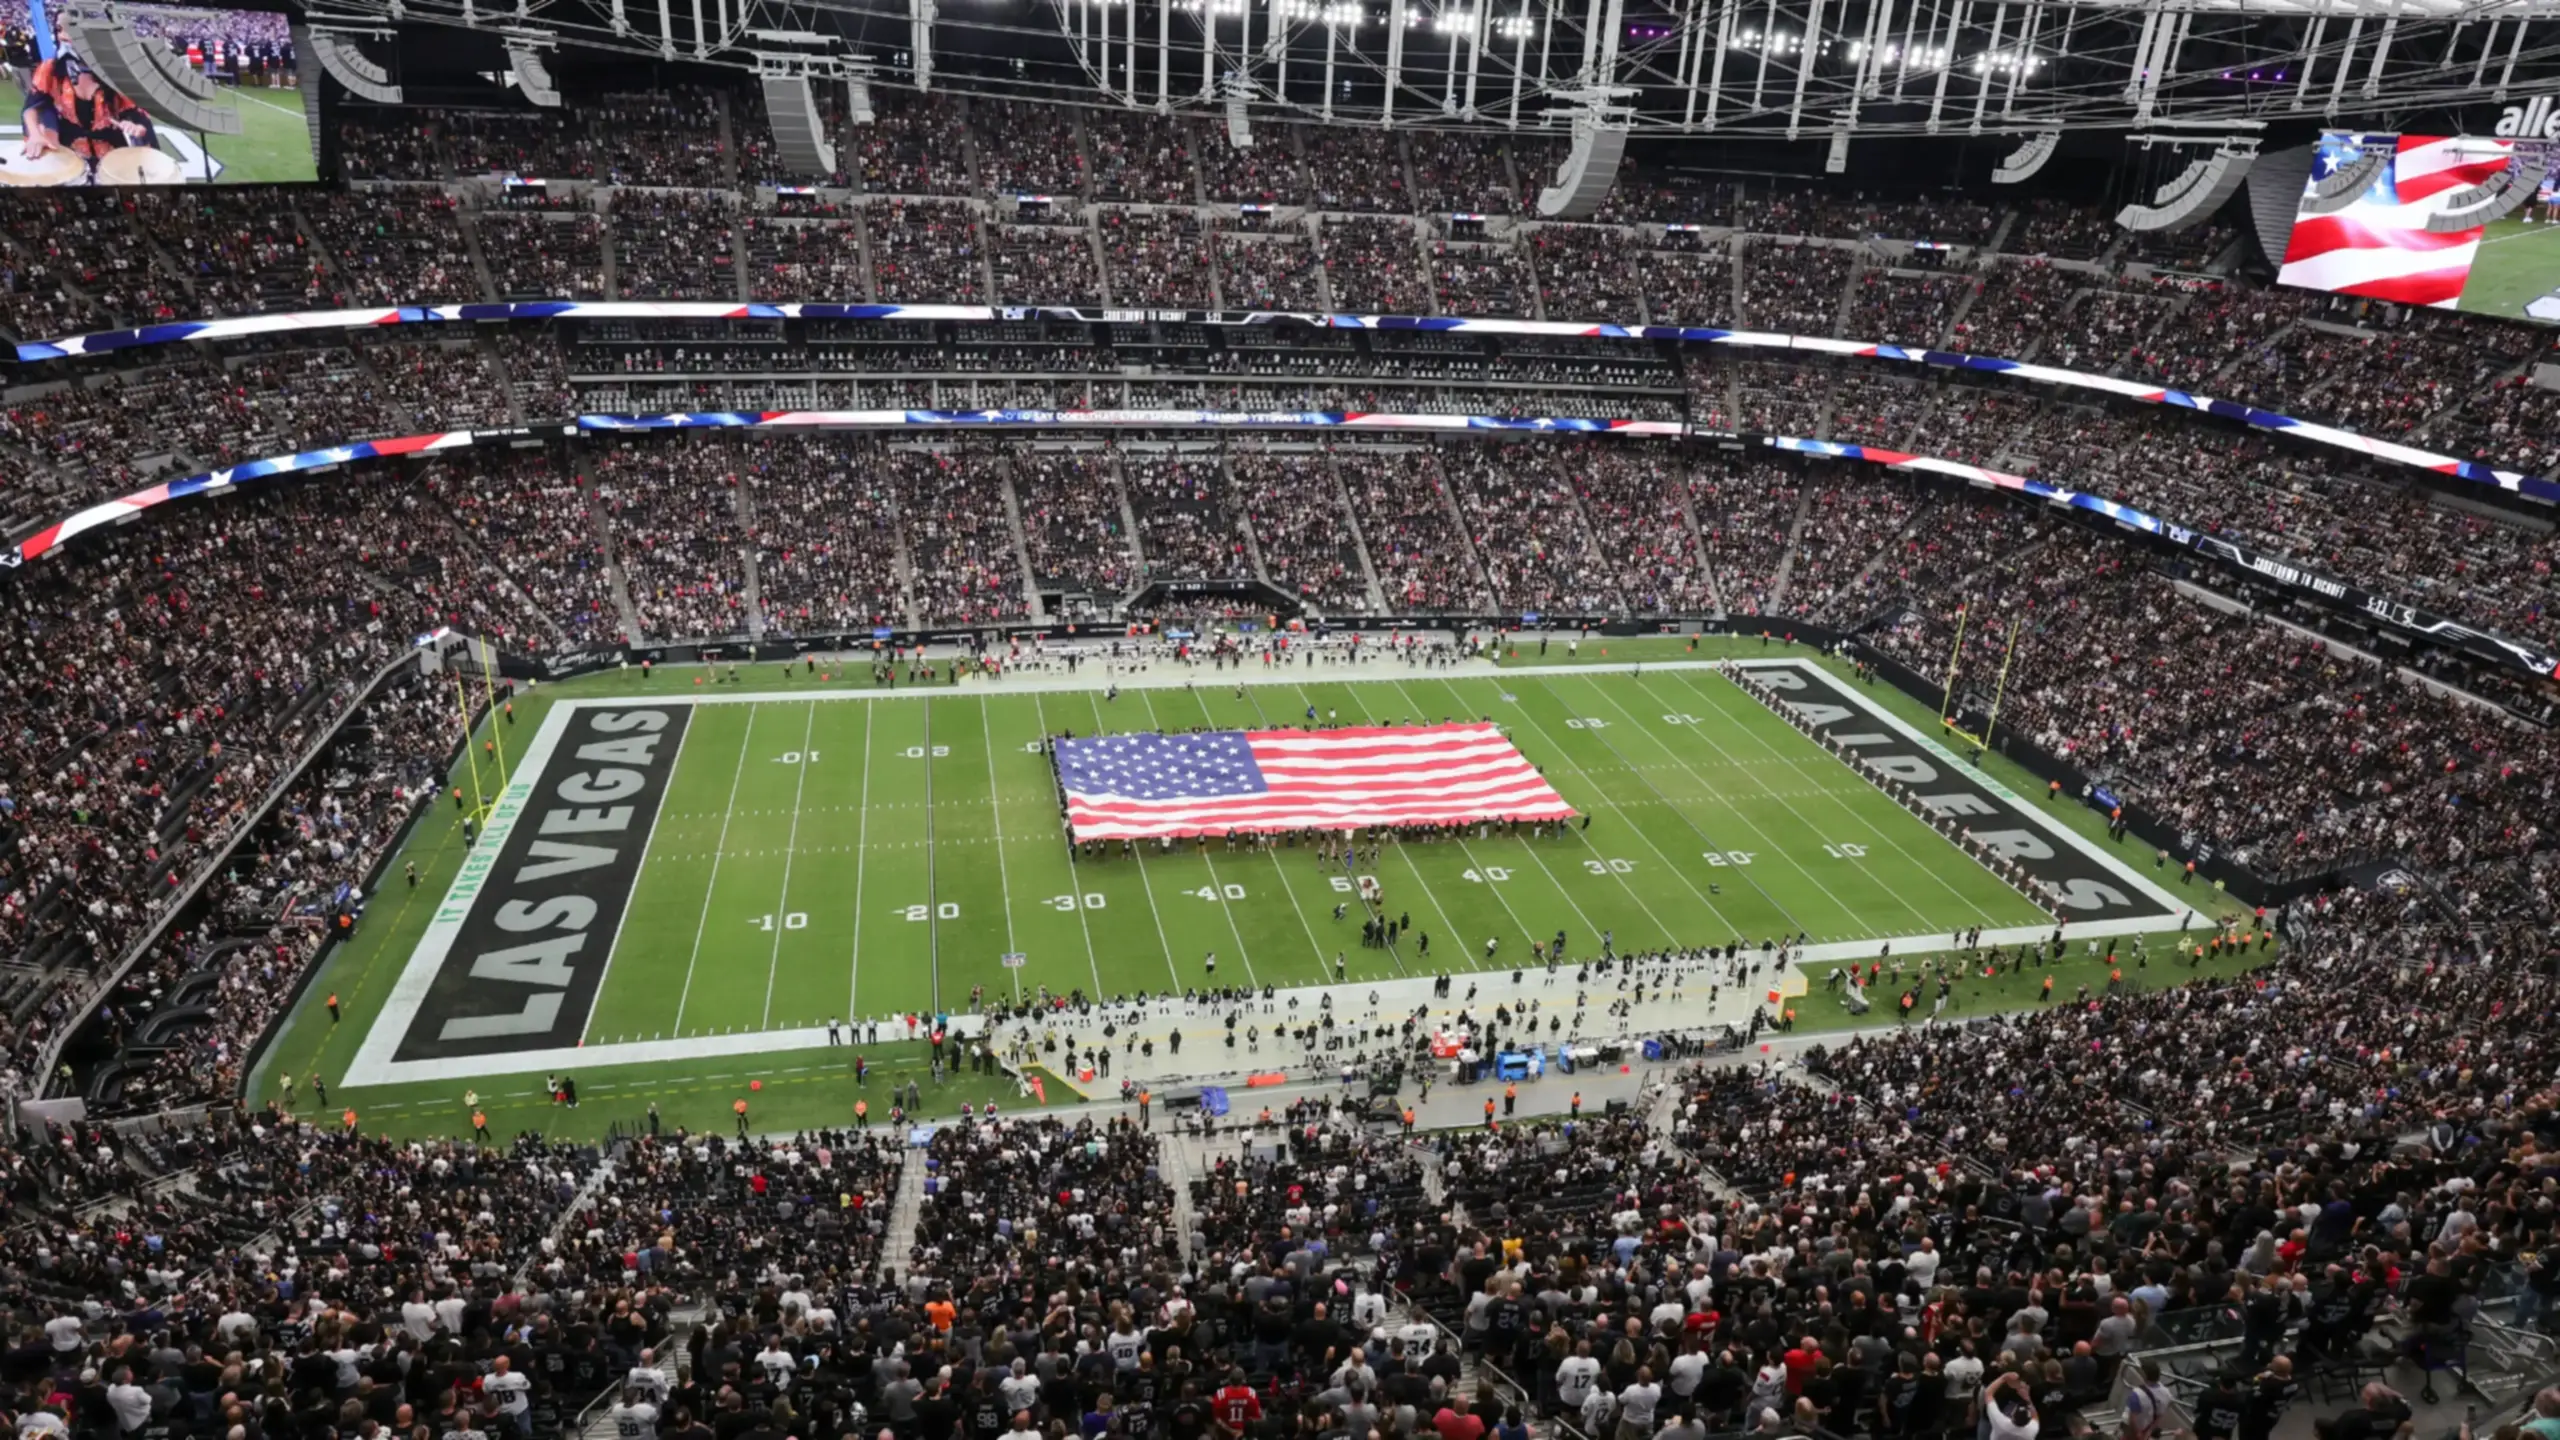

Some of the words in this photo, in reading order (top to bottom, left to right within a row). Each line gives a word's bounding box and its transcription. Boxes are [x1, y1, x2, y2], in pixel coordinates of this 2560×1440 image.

[2495, 97, 2560, 137] alle
[513, 709, 670, 884] VEGAS
[1748, 670, 2133, 911] RAIDERS
[495, 803, 519, 818] OF
[479, 824, 510, 848] ALL
[1702, 850, 1752, 867] 20
[1821, 843, 1867, 859] 10
[1462, 866, 1510, 883] 40
[1583, 858, 1633, 876] 30
[450, 854, 493, 901] TAKES
[1196, 883, 1247, 902] 40
[1053, 893, 1107, 912] 30
[437, 907, 465, 922] IT
[905, 902, 960, 922] 20
[759, 912, 809, 932] 10
[437, 894, 599, 1041] LAS
[1406, 1340, 1431, 1356] 34
[1573, 1374, 1591, 1389] 17
[1229, 1407, 1244, 1422] 11
[618, 1422, 639, 1437] 28
